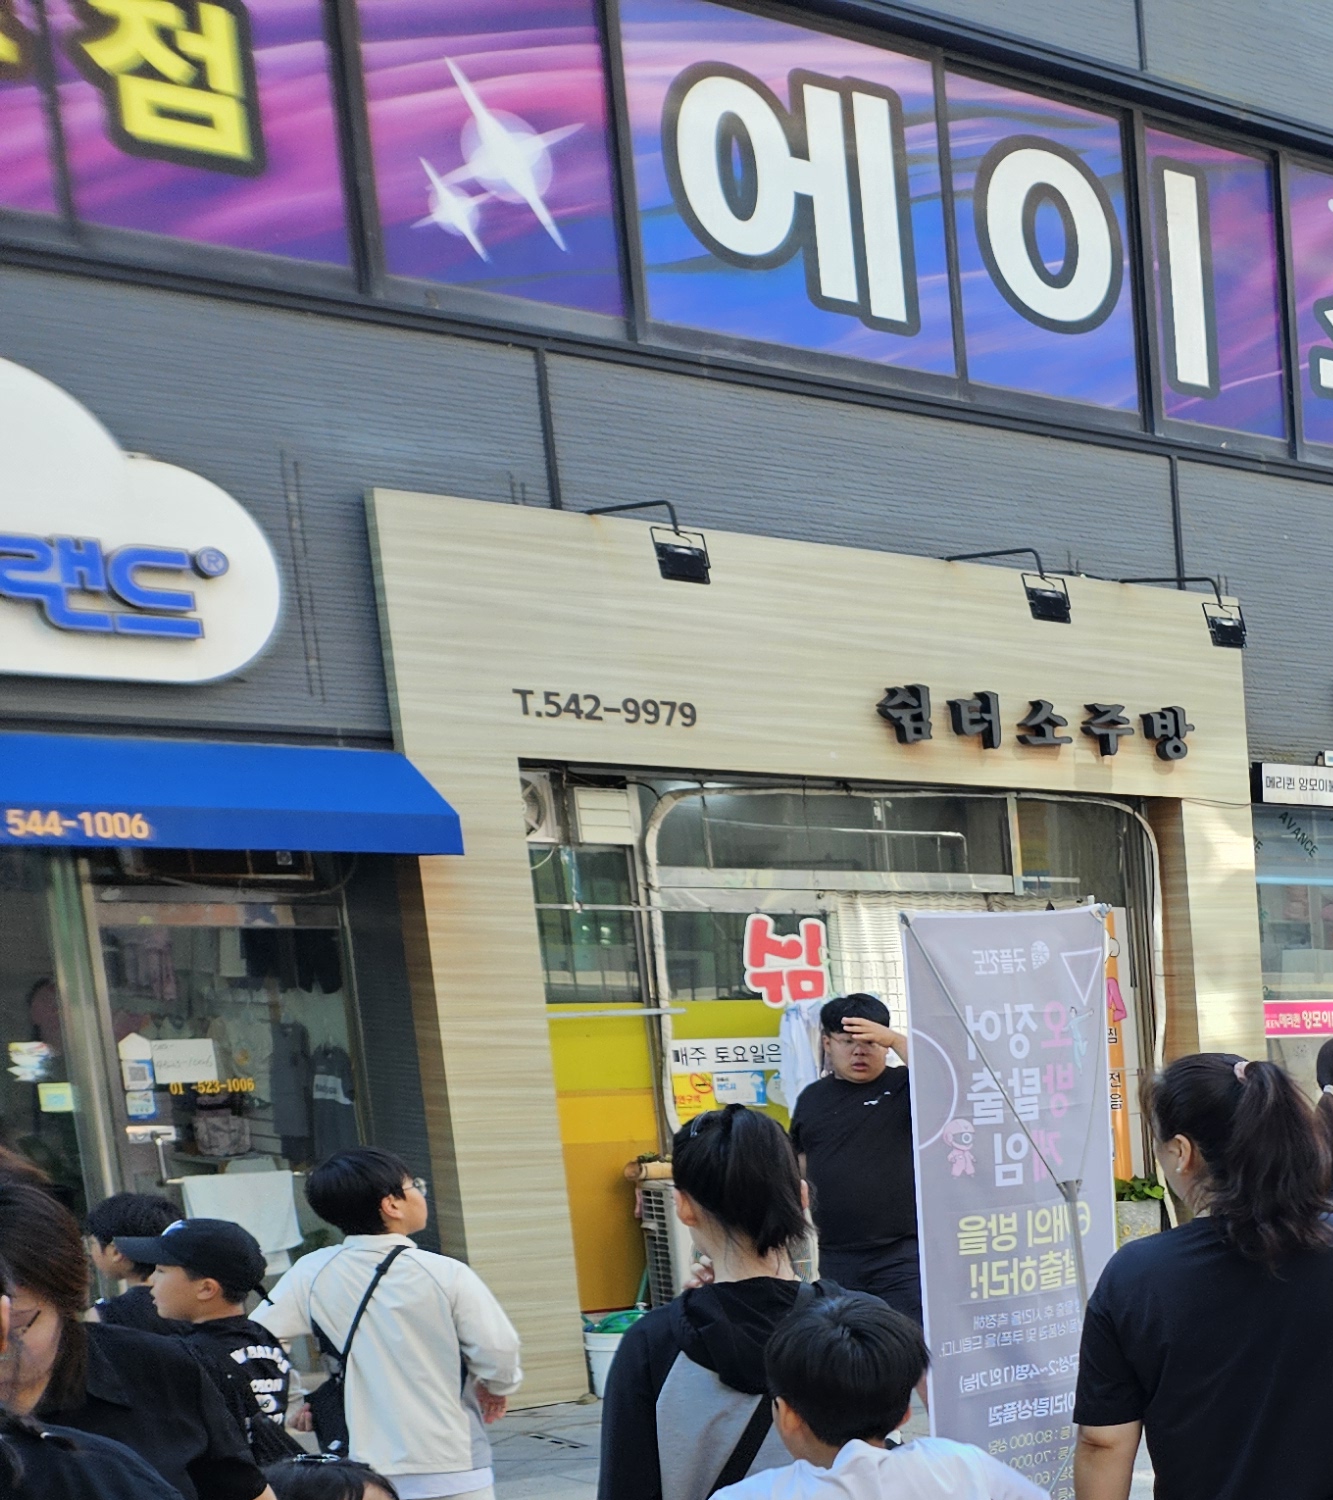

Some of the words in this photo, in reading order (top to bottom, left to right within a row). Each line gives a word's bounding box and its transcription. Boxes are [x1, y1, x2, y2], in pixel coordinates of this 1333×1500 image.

[512, 687, 698, 729] T.542-9979
[877, 683, 1196, 762] 쉼터소주방
[5, 809, 150, 840] 544-1006
[1278, 811, 1319, 858] AVANCE
[672, 1046, 708, 1068] 매주
[168, 1077, 256, 1097] 01-523-1006
